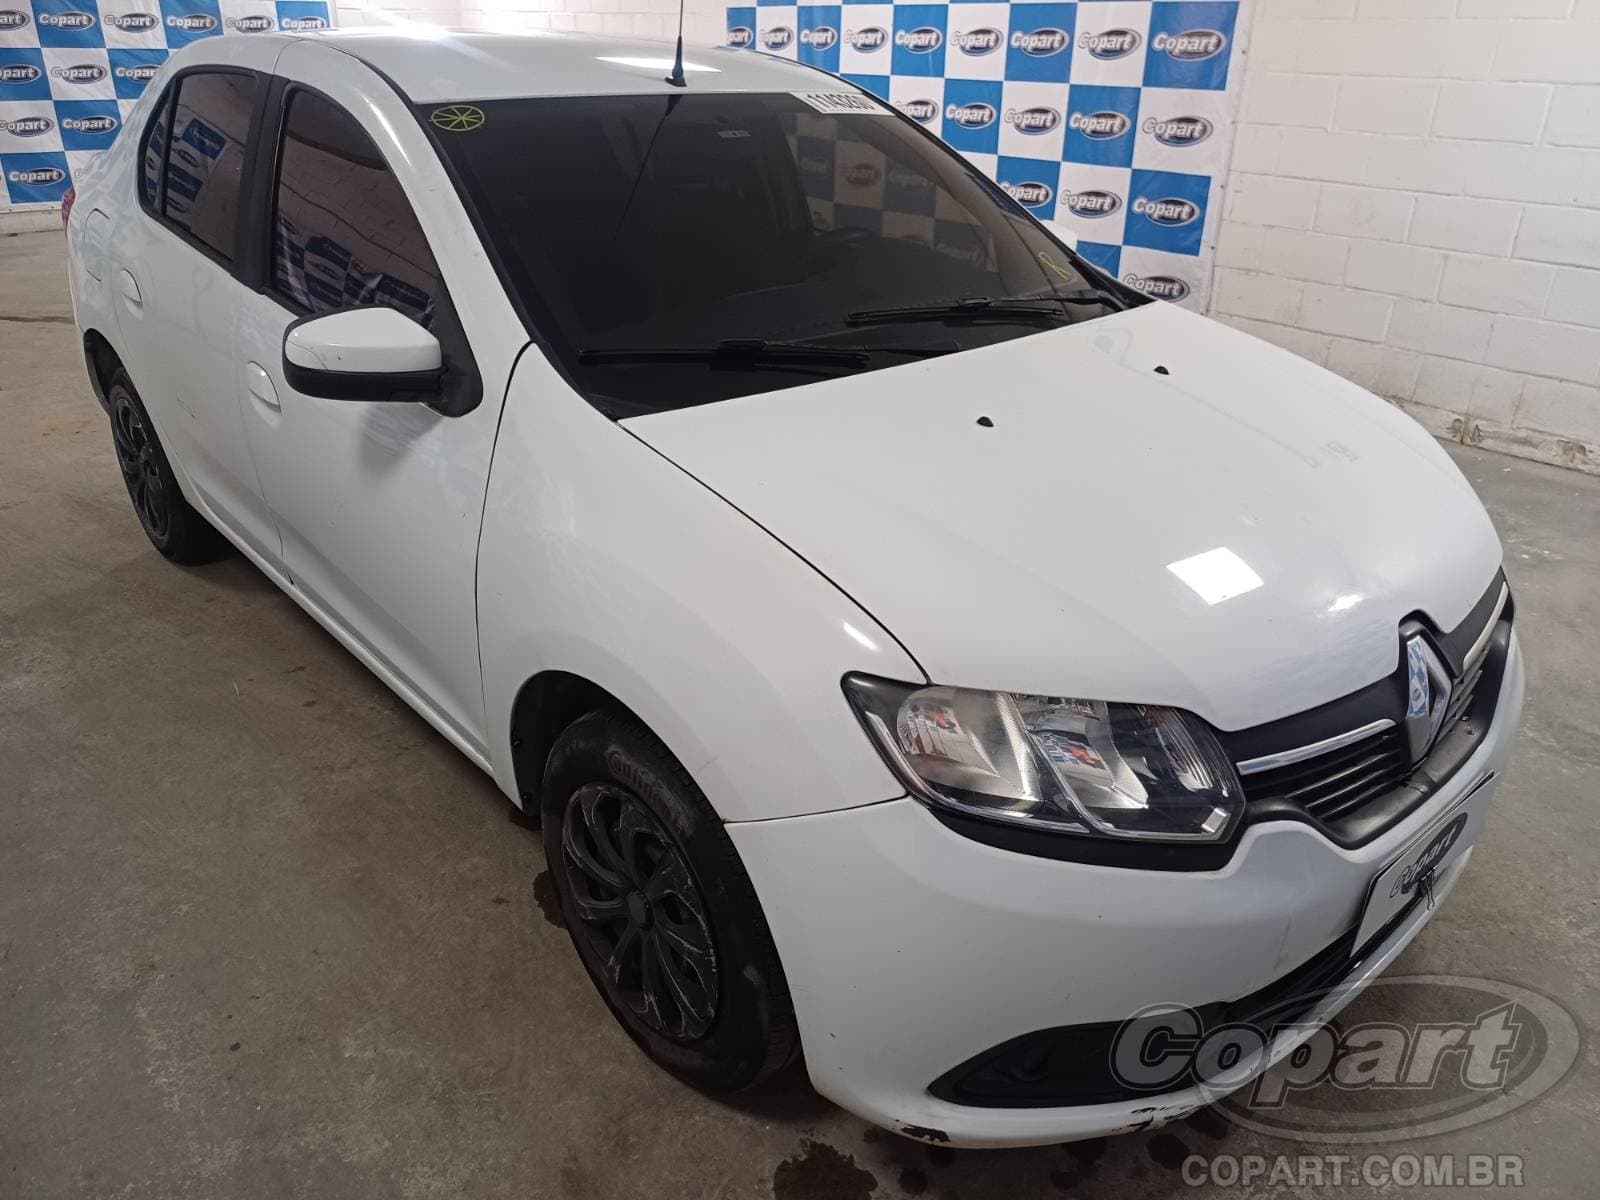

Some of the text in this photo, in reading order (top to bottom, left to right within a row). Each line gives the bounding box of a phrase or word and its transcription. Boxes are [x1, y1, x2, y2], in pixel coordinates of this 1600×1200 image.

[38, 13, 90, 28] Copart
[104, 14, 153, 28] Copart
[166, 15, 215, 30] Copart
[226, 17, 270, 30] Copart
[281, 18, 323, 31] Copart
[800, 29, 834, 46] Copart
[845, 29, 885, 48] Copart
[895, 30, 938, 48] Copart
[952, 31, 996, 49] Copart
[1010, 32, 1063, 50] Copart
[1077, 33, 1137, 53] Copart
[1152, 33, 1218, 55] Copart
[51, 66, 100, 80] Copart
[115, 67, 157, 79] Copar
[945, 103, 993, 123] Copart
[1004, 109, 1054, 130] Copart
[63, 118, 112, 132] Copart
[1069, 113, 1124, 135] Copart
[1143, 118, 1204, 142] Copart
[9, 170, 60, 184] Copart
[1060, 190, 1115, 213] Copart
[1132, 198, 1192, 221] Copart
[1123, 274, 1181, 297] Copart
[1390, 824, 1458, 898] Copart
